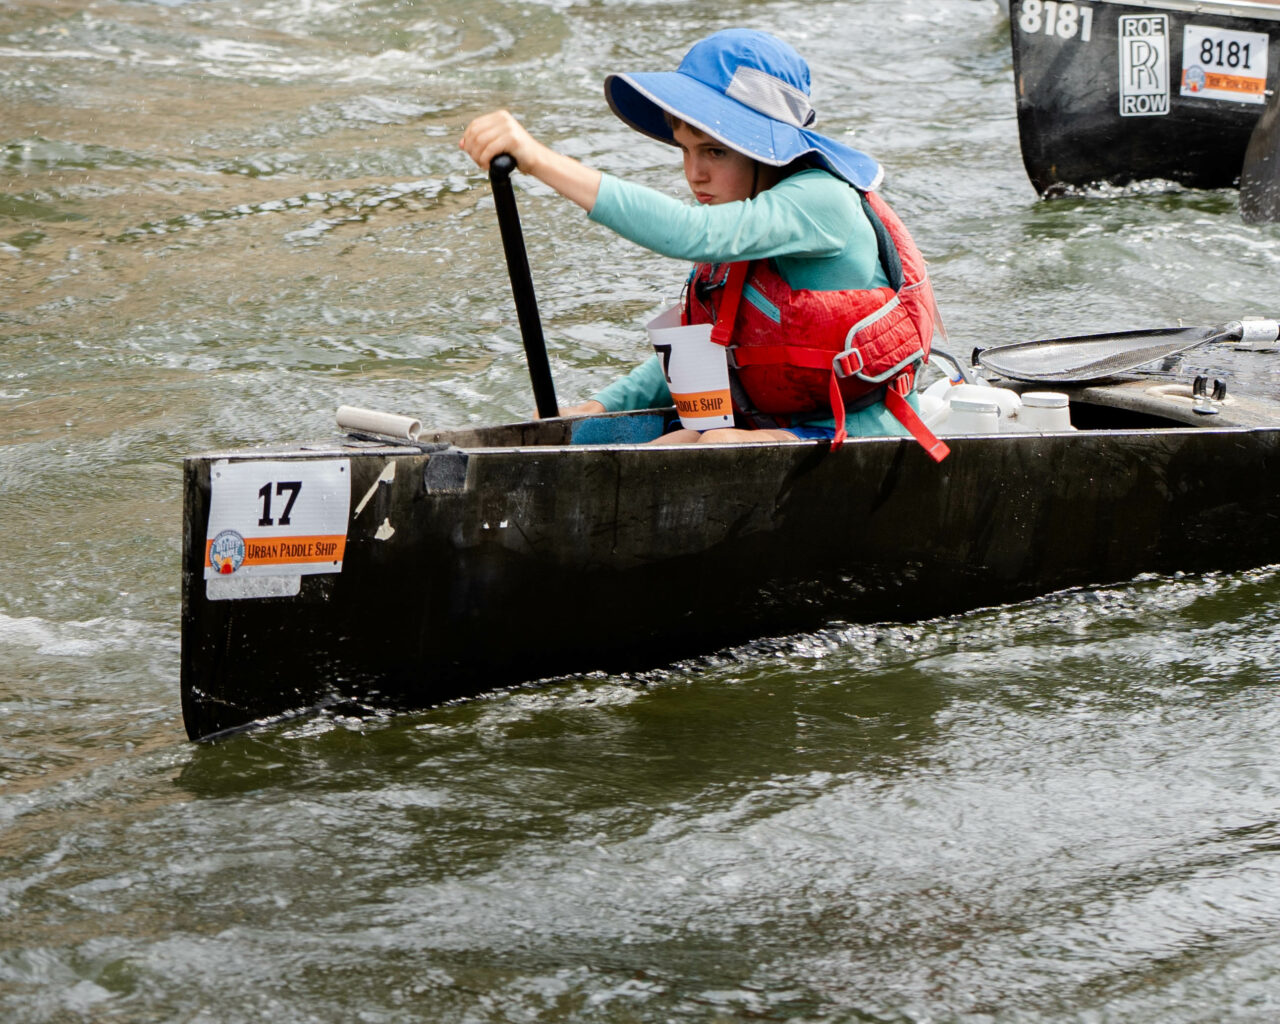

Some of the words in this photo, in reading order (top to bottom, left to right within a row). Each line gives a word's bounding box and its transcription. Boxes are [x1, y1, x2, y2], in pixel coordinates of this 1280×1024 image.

[1125, 19, 1162, 36] ROE
[1200, 38, 1251, 69] 8181
[1124, 95, 1167, 113] ROW
[676, 399, 699, 413] ADDLE
[257, 480, 303, 527] 17
